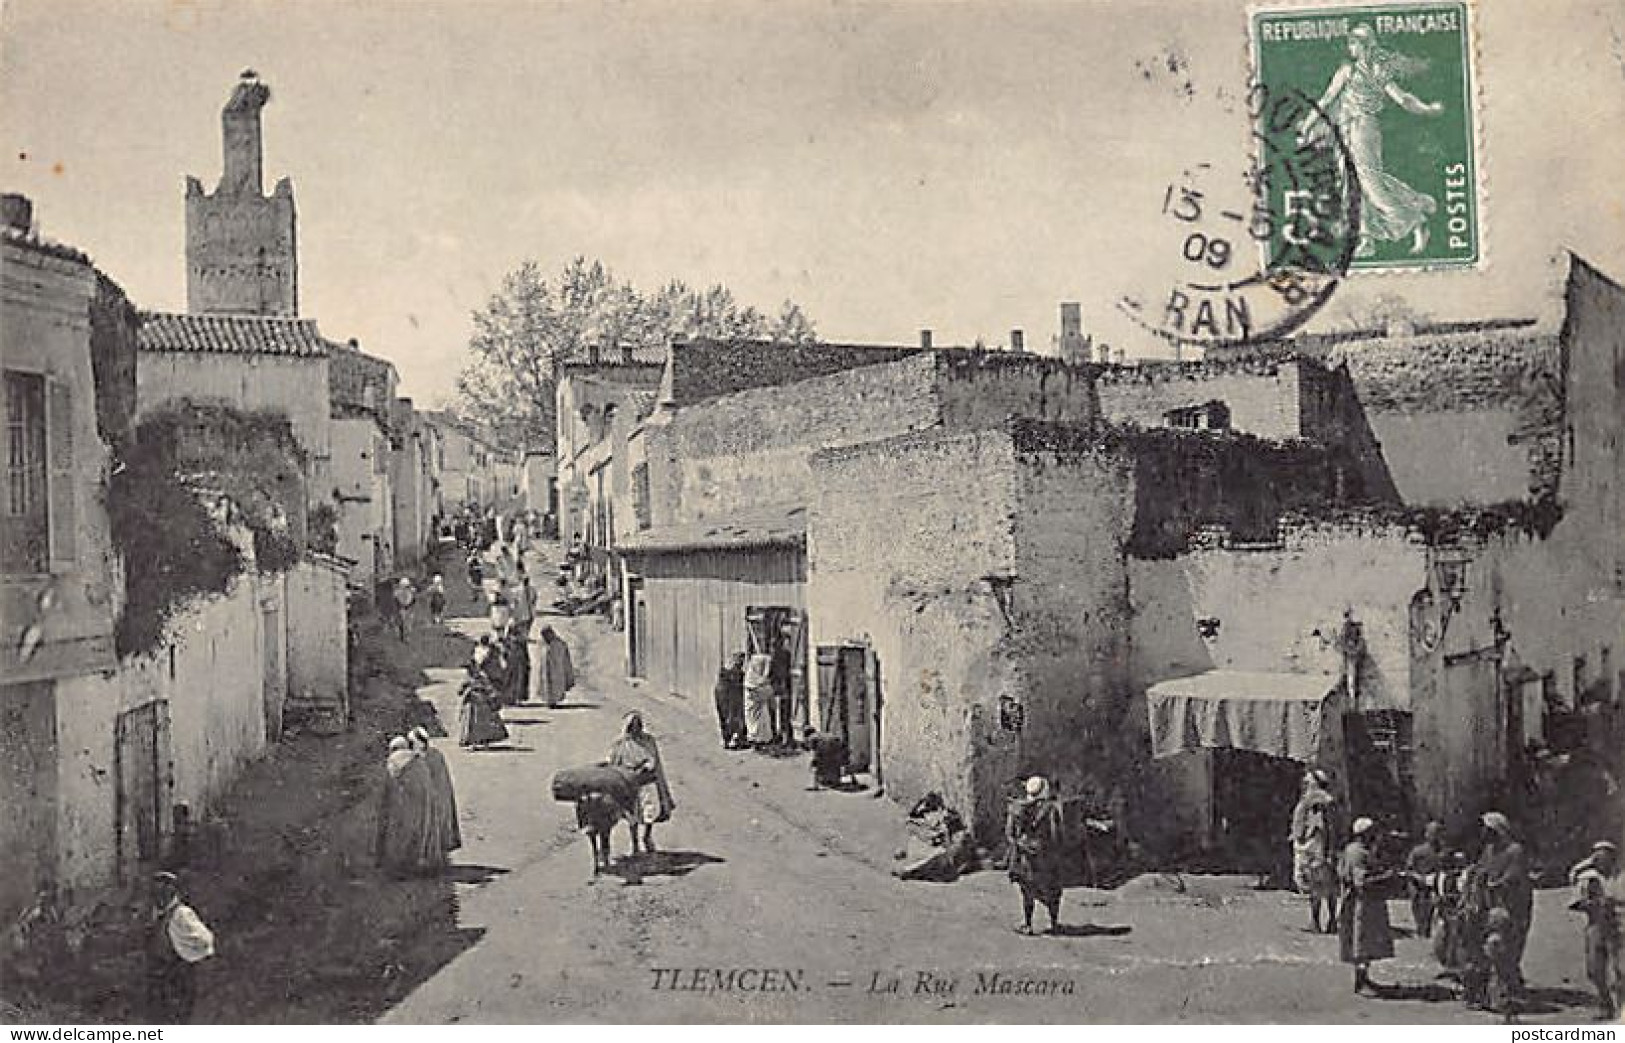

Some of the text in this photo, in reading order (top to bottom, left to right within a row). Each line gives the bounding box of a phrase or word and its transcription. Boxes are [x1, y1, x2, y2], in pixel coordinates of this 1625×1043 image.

[1376, 12, 1461, 34] FRANÇAISE
[1446, 162, 1466, 250] POSTES
[1183, 233, 1231, 269] 09
